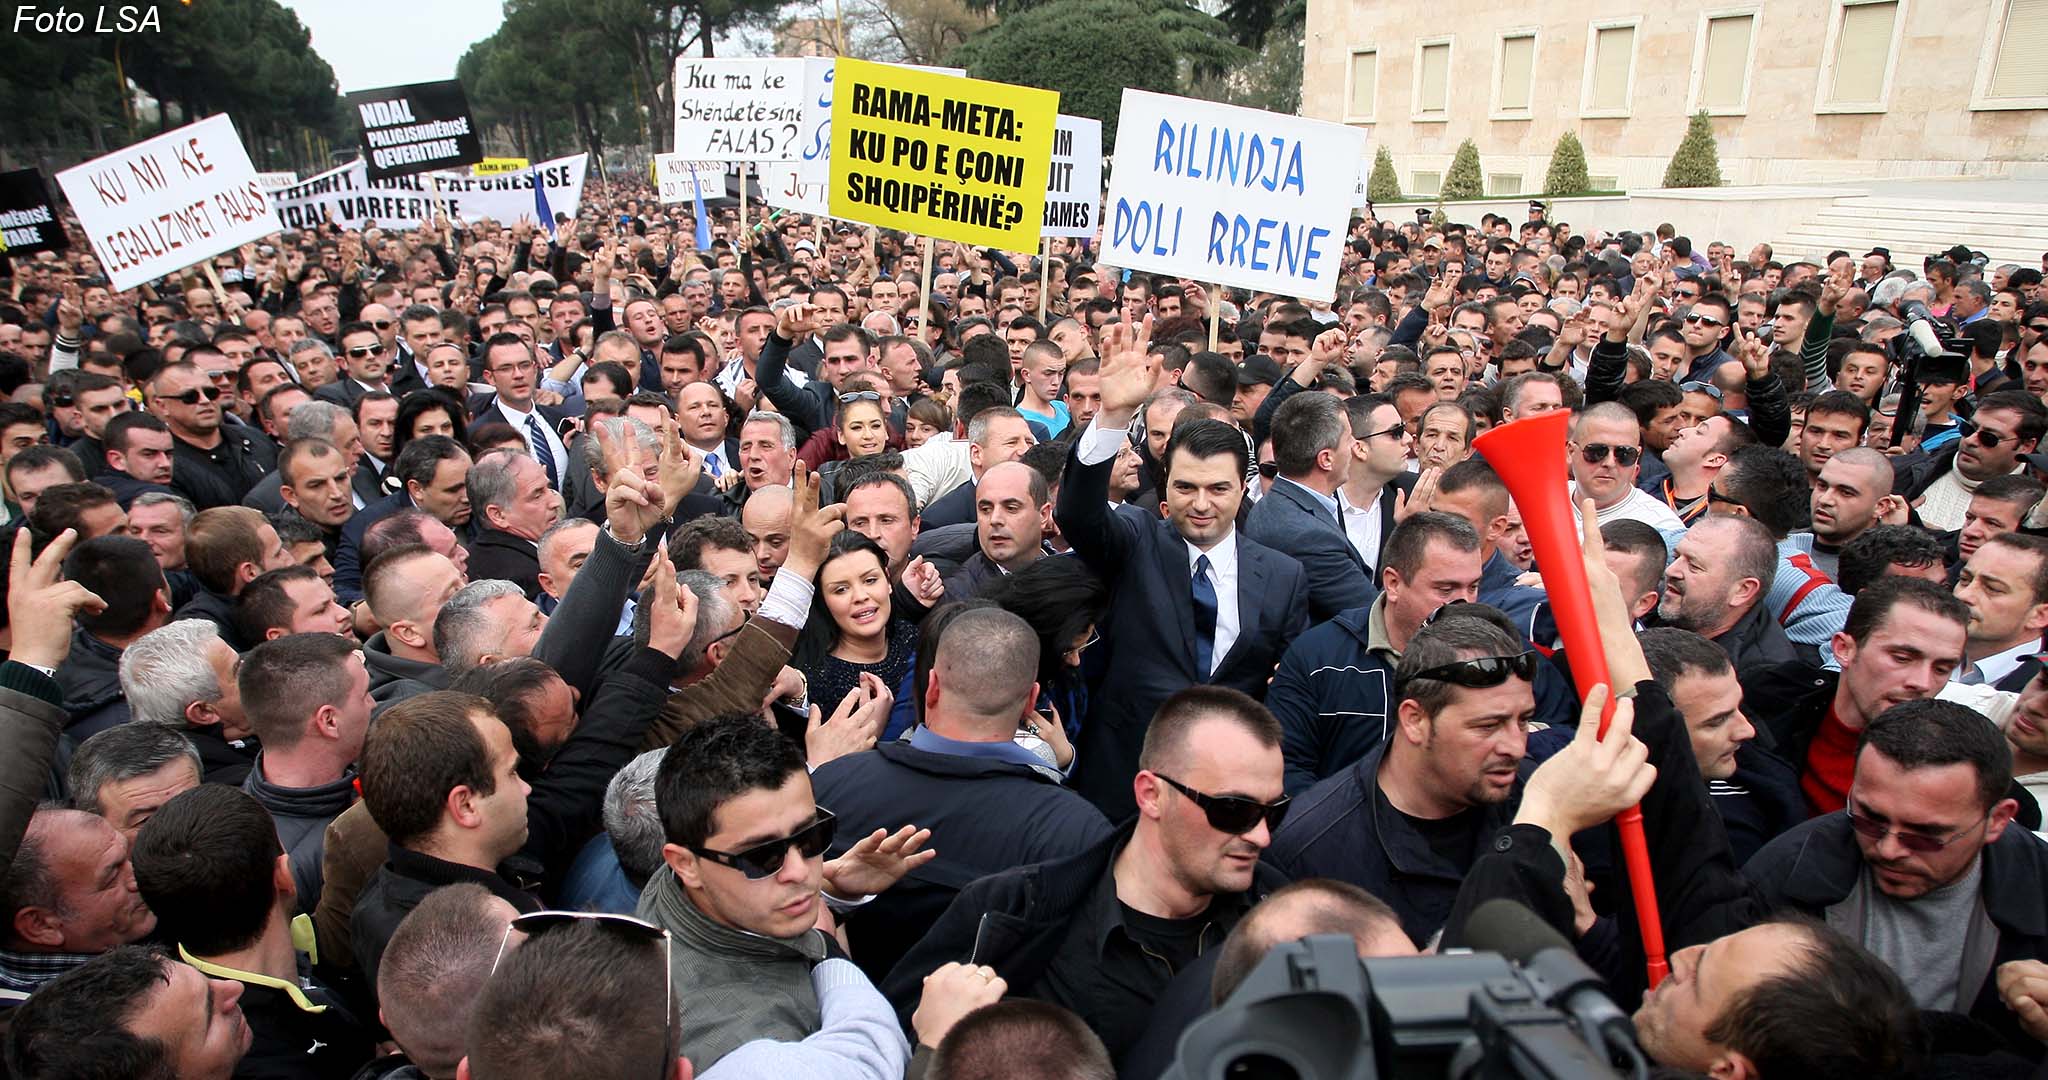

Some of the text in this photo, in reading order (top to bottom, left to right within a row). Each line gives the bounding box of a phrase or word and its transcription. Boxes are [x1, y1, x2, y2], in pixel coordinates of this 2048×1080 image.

[684, 64, 786, 90] Ku ma ke
[358, 98, 416, 128] NDAL
[366, 116, 470, 148] PALIGJSHMËRISË
[852, 83, 1024, 142] RAMA-META:
[88, 137, 214, 208] KU MI KE
[372, 138, 460, 169] QEVERITARE
[849, 128, 886, 164] KU
[892, 136, 928, 171] PO
[934, 144, 949, 175] E
[955, 148, 1025, 188] ÇONI
[1153, 118, 1305, 196] RILINDJA
[97, 180, 267, 272] LEGALIZIMET FALAS
[847, 172, 1023, 231] SHQIPËRINË?
[1113, 196, 1331, 281] DOLI RRENE
